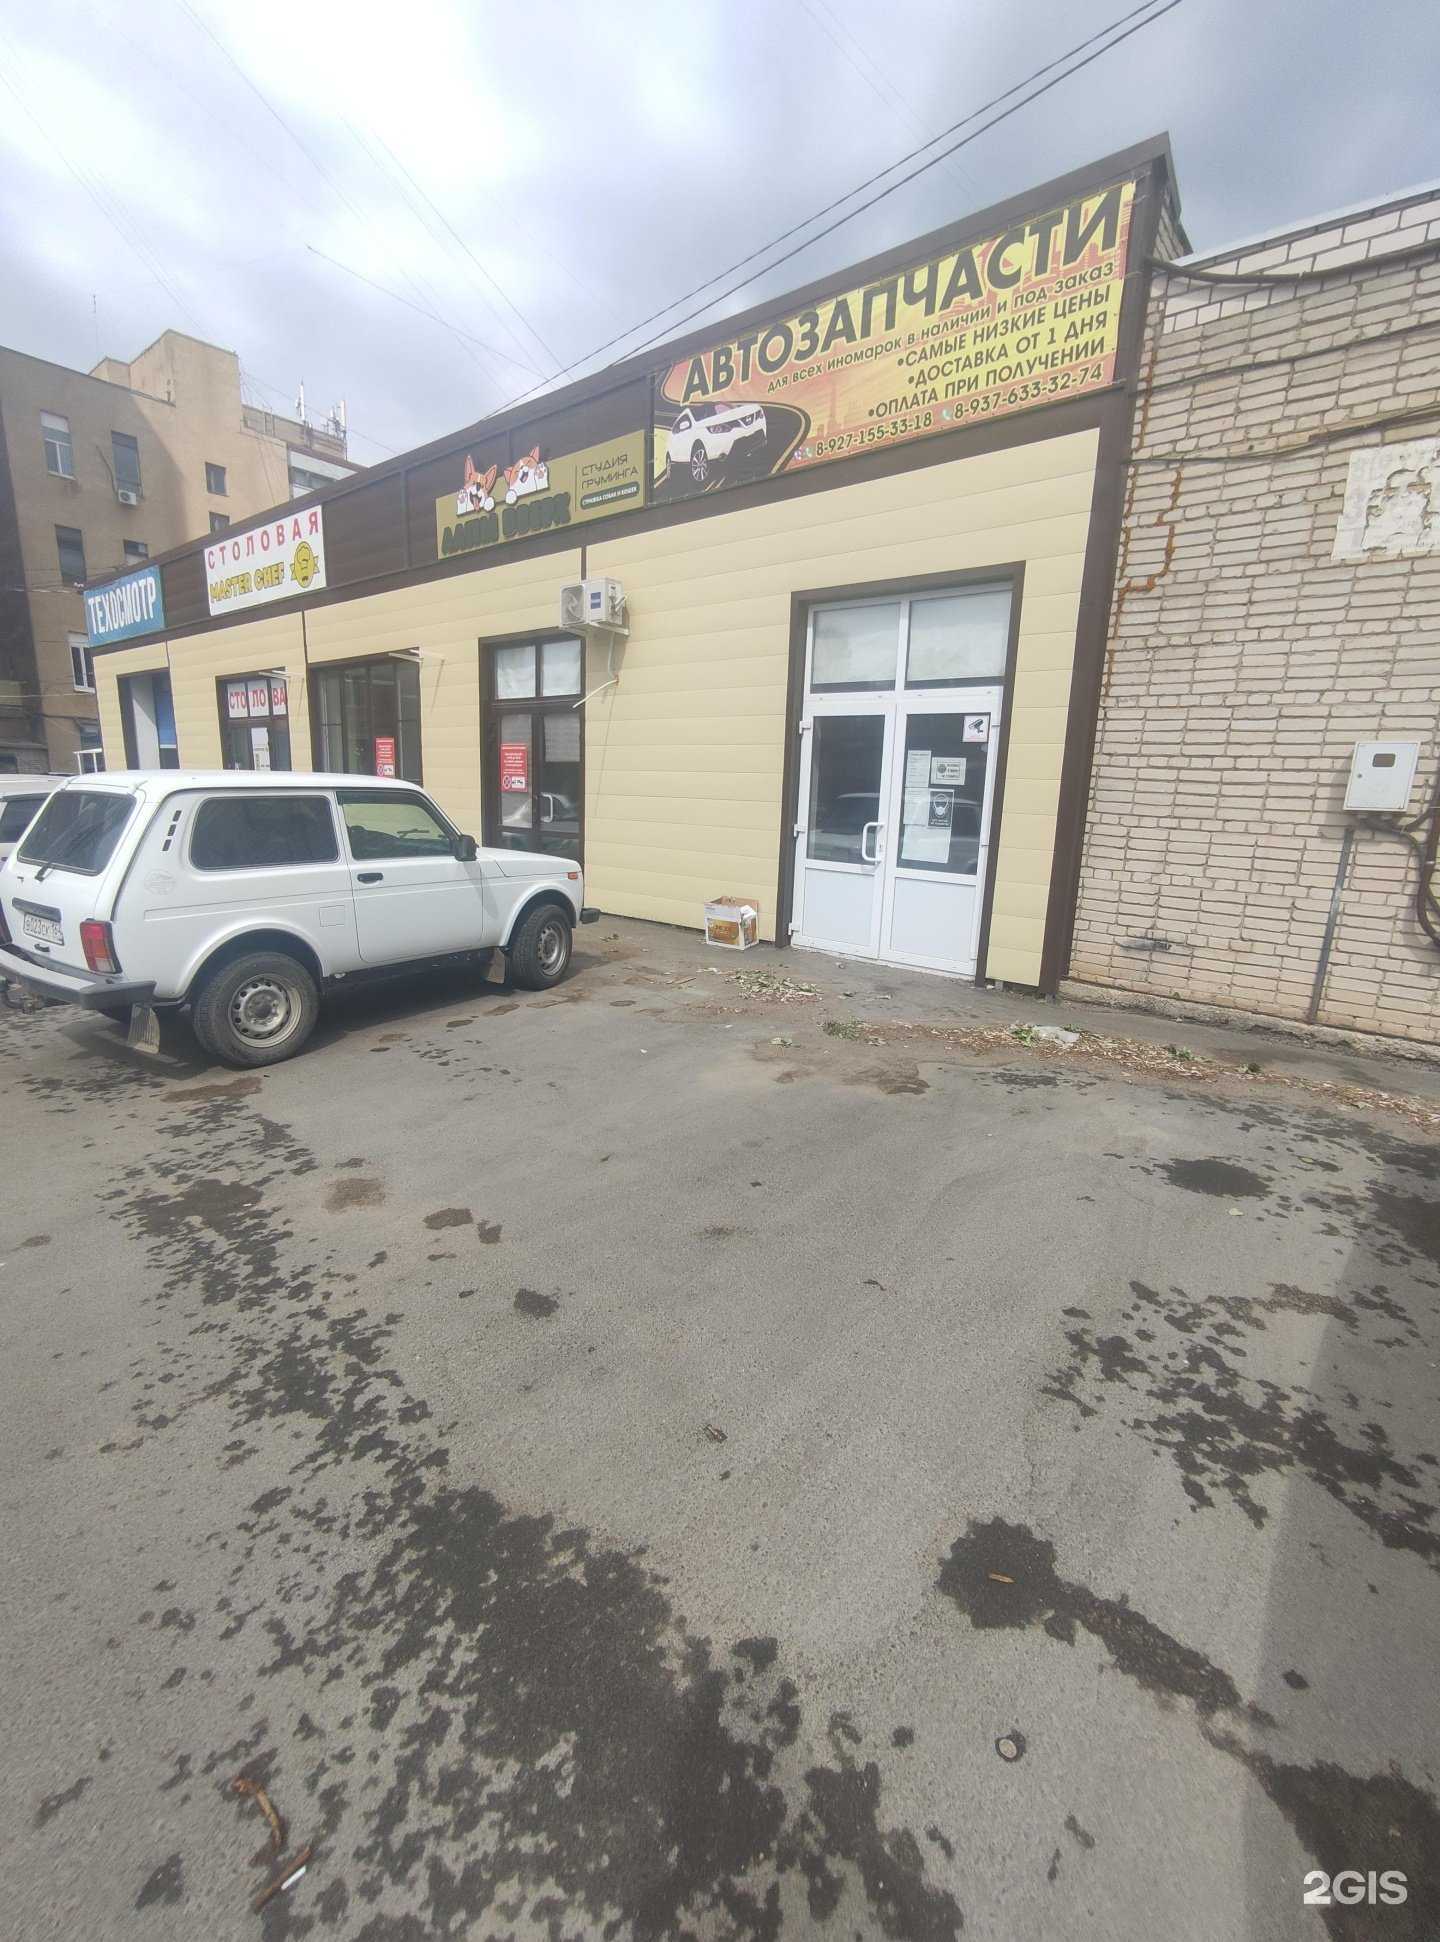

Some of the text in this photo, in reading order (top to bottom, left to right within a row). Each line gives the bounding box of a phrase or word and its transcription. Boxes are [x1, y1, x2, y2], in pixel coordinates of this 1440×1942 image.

[682, 191, 1122, 402] АВТОЗАПЧАСТИ
[973, 306, 1046, 346] НИЗКИЕ
[1054, 285, 1111, 319] ЦЕНЫ
[768, 262, 1113, 393] для всех иномарок в наличии и под заказ
[1016, 332, 1040, 354] ОТ
[1048, 328, 1056, 345] 1
[1064, 311, 1108, 343] ДНЯ
[945, 374, 978, 399] ПРИ
[986, 337, 1104, 387] ПОЛУЧЕНИИ
[816, 364, 1102, 456] 8-927-155-33-18 8-937-633-32-74
[582, 454, 628, 476] СТУДИЯ
[582, 466, 638, 488] ГРУМИНГА
[208, 511, 318, 569] СТОЛОВАЯ
[88, 577, 157, 635] ТЕХОСМОТР
[209, 562, 284, 603] MASTER CHEF
